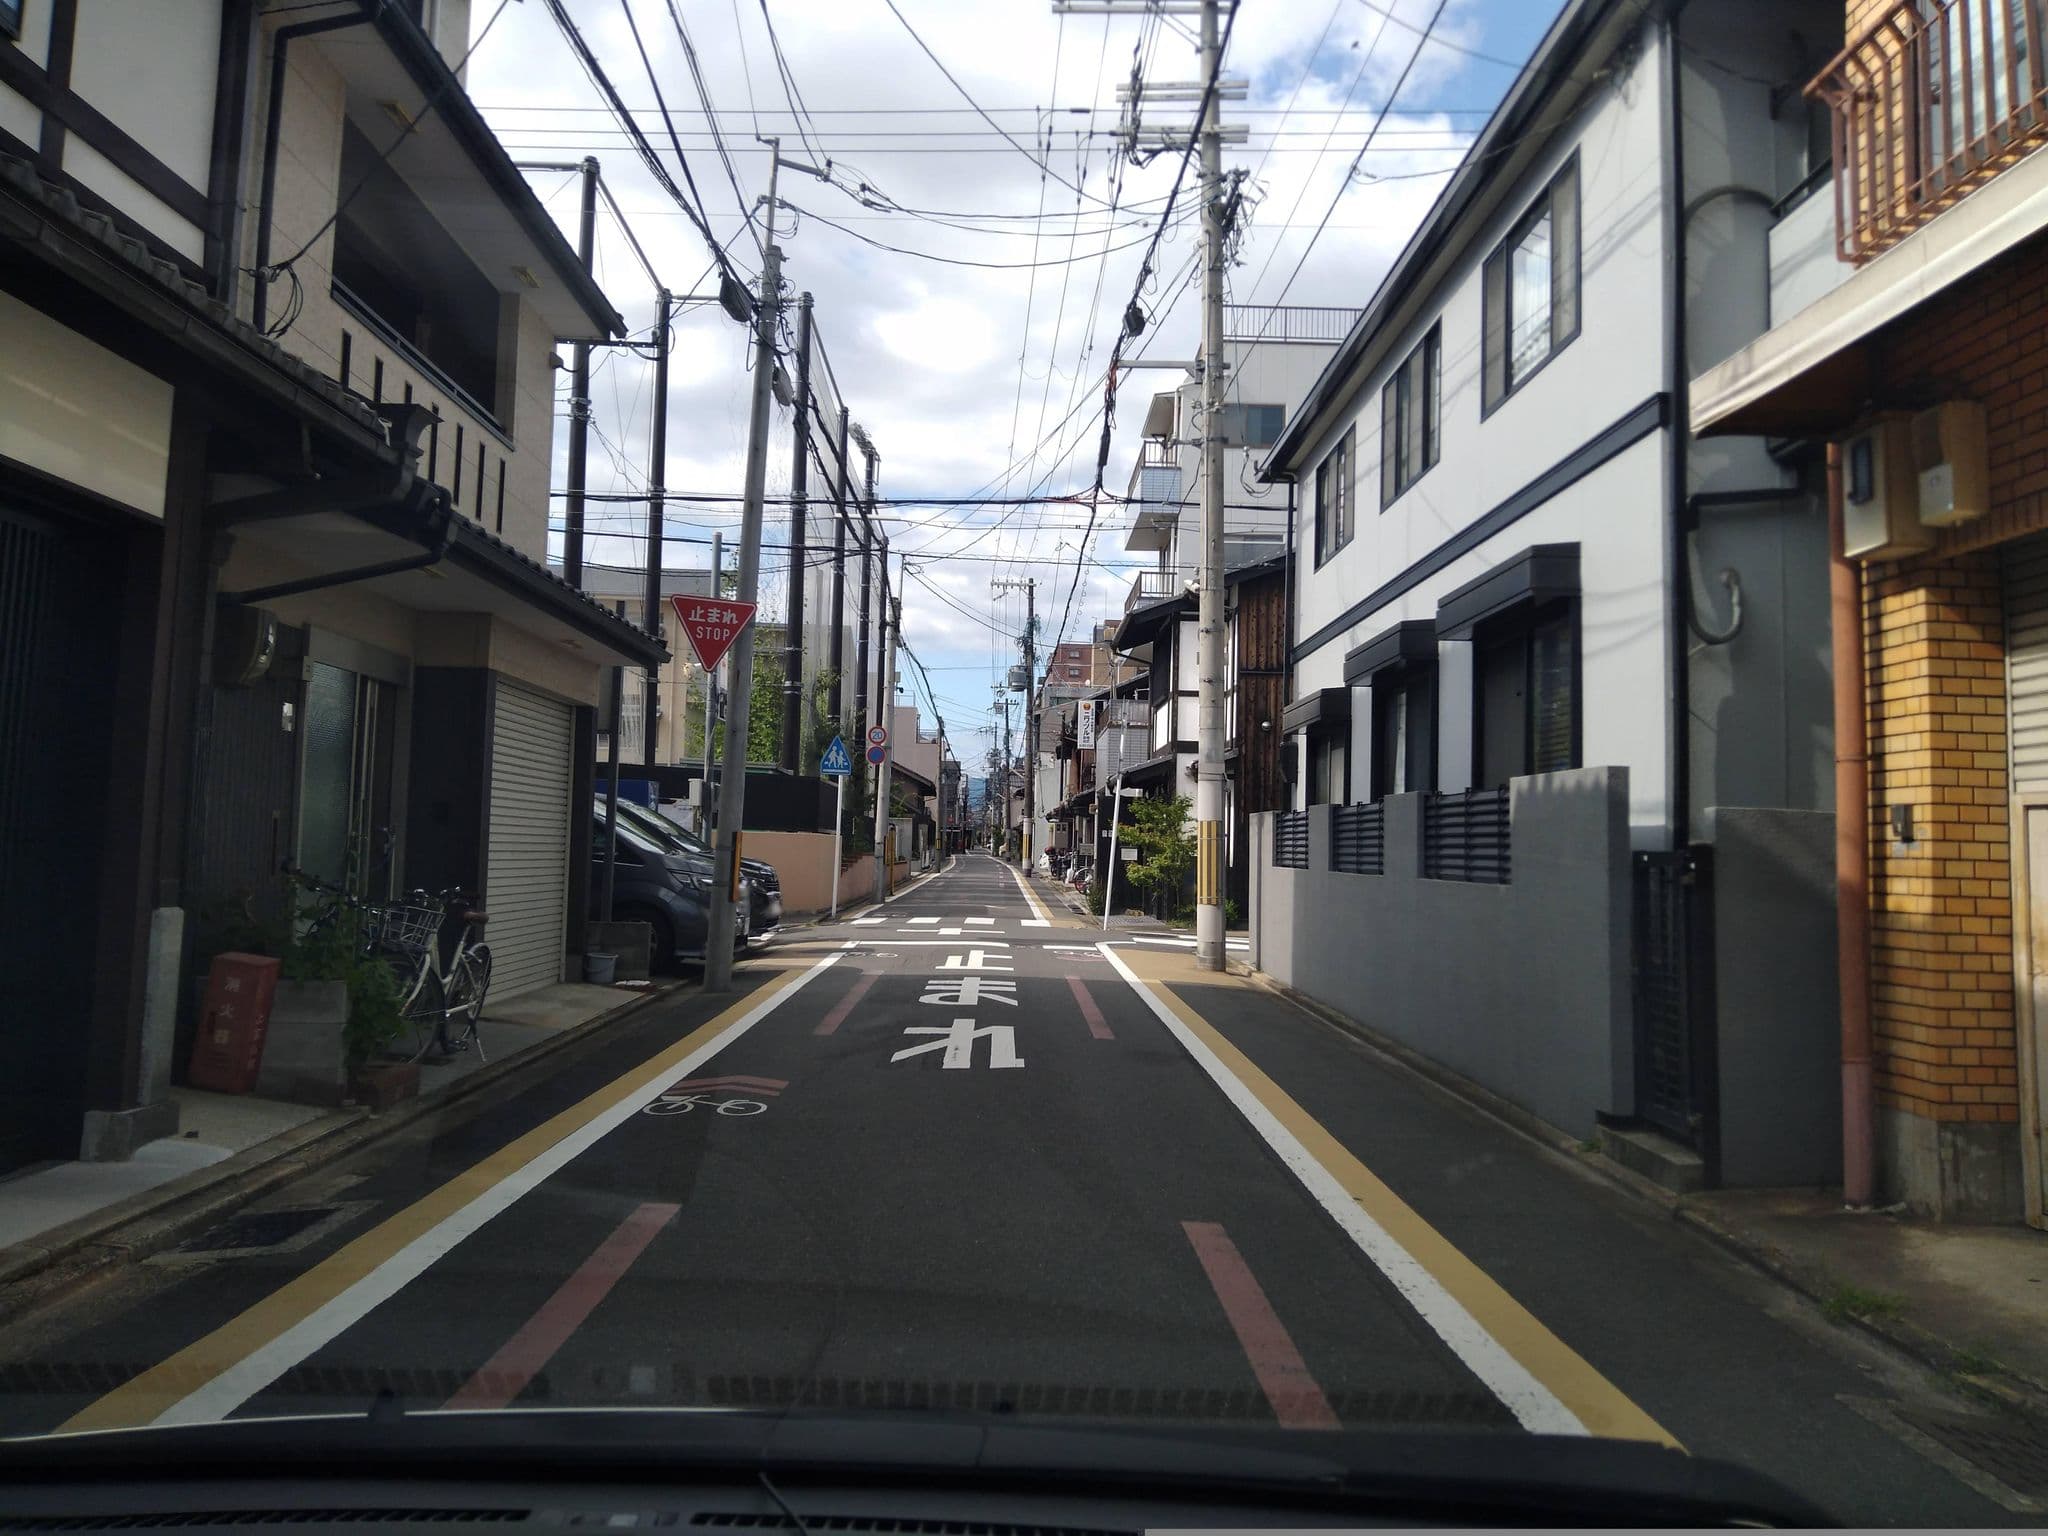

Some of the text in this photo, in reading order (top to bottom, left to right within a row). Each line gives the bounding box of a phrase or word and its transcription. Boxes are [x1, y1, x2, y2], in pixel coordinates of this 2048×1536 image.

[688, 605, 738, 625] 止まれ
[696, 626, 731, 641] STOP
[872, 731, 882, 740] 20
[890, 949, 1025, 1070] 止まれ
